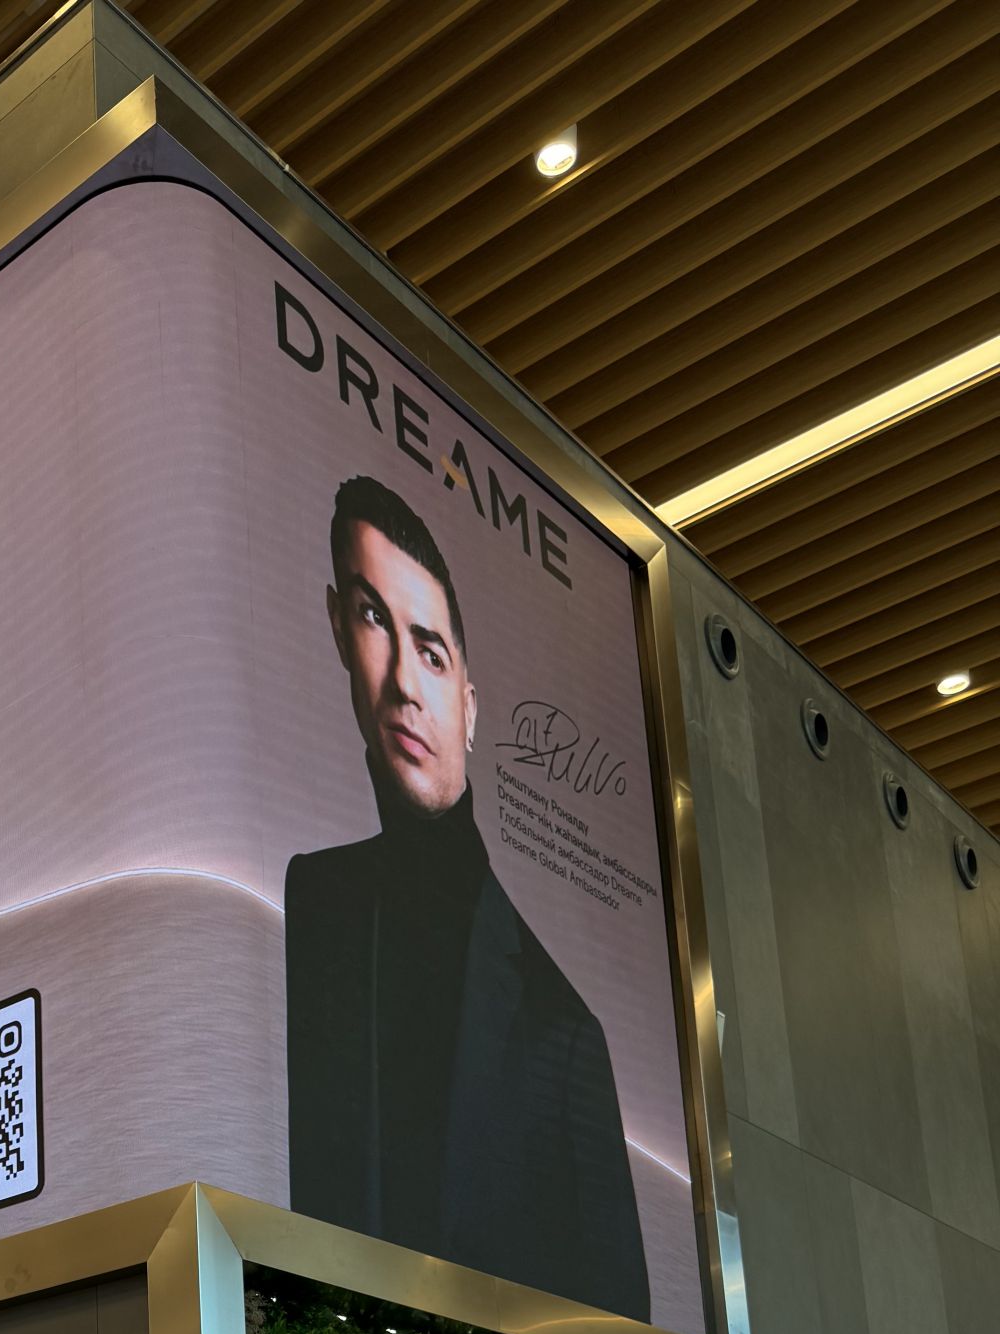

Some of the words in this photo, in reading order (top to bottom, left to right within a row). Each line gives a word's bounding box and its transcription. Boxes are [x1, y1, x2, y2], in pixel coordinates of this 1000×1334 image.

[274, 280, 573, 590] DREAME
[496, 762, 549, 811] Криштиану
[551, 799, 588, 837] Роналду
[499, 806, 556, 853] Глобальный
[558, 845, 609, 887] амбассадор
[611, 876, 642, 906] Dreame
[501, 827, 537, 861] Dreame
[539, 852, 567, 880] Global
[569, 869, 619, 910] Ambassador
